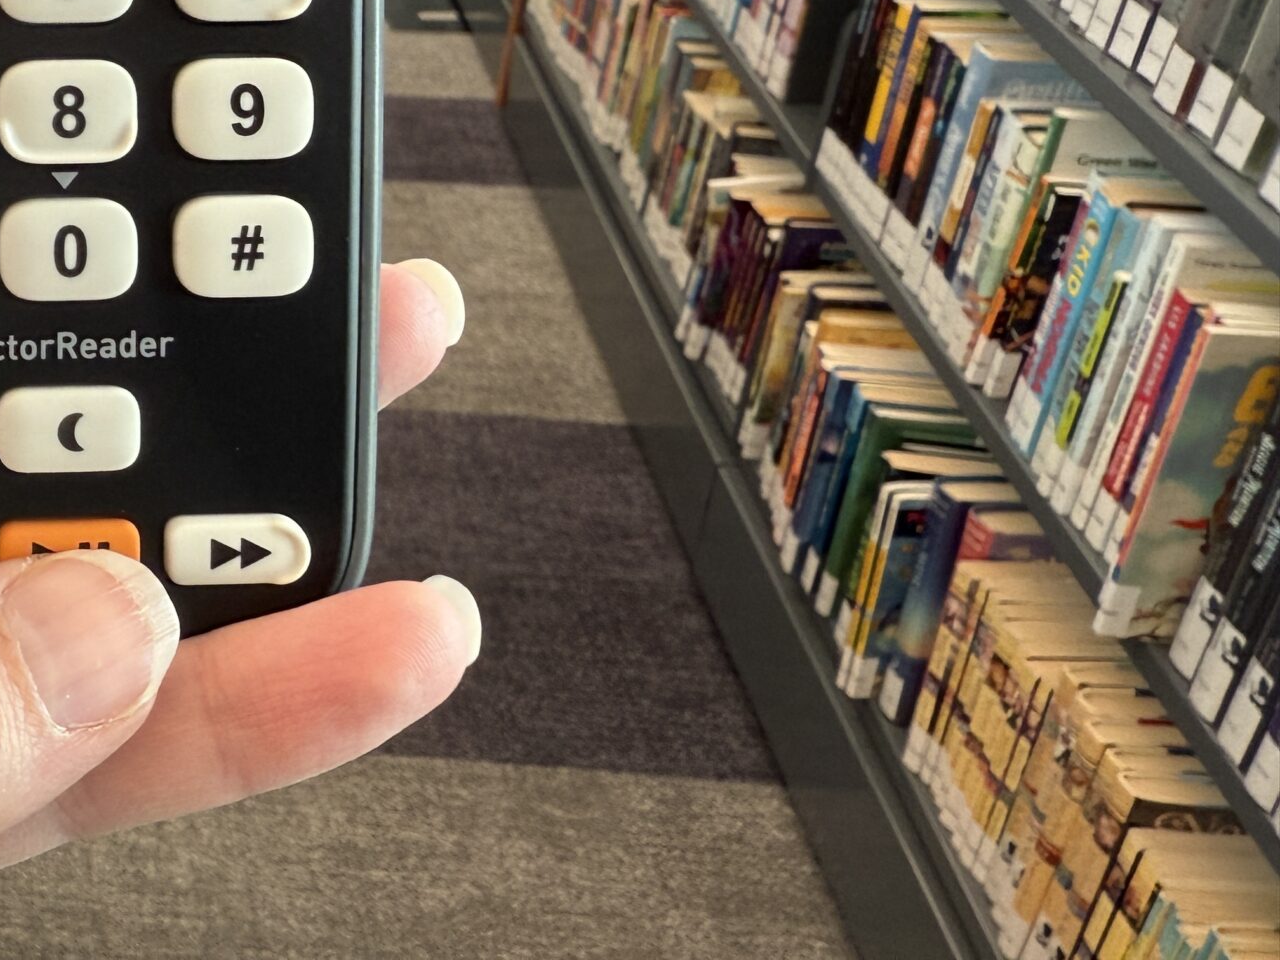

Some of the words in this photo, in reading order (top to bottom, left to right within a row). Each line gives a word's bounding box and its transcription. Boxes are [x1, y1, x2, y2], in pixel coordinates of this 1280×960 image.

[52, 85, 87, 139] 8
[230, 83, 265, 137] 9
[53, 224, 88, 278] 0
[231, 225, 265, 271] #
[1066, 242, 1092, 299] KID
